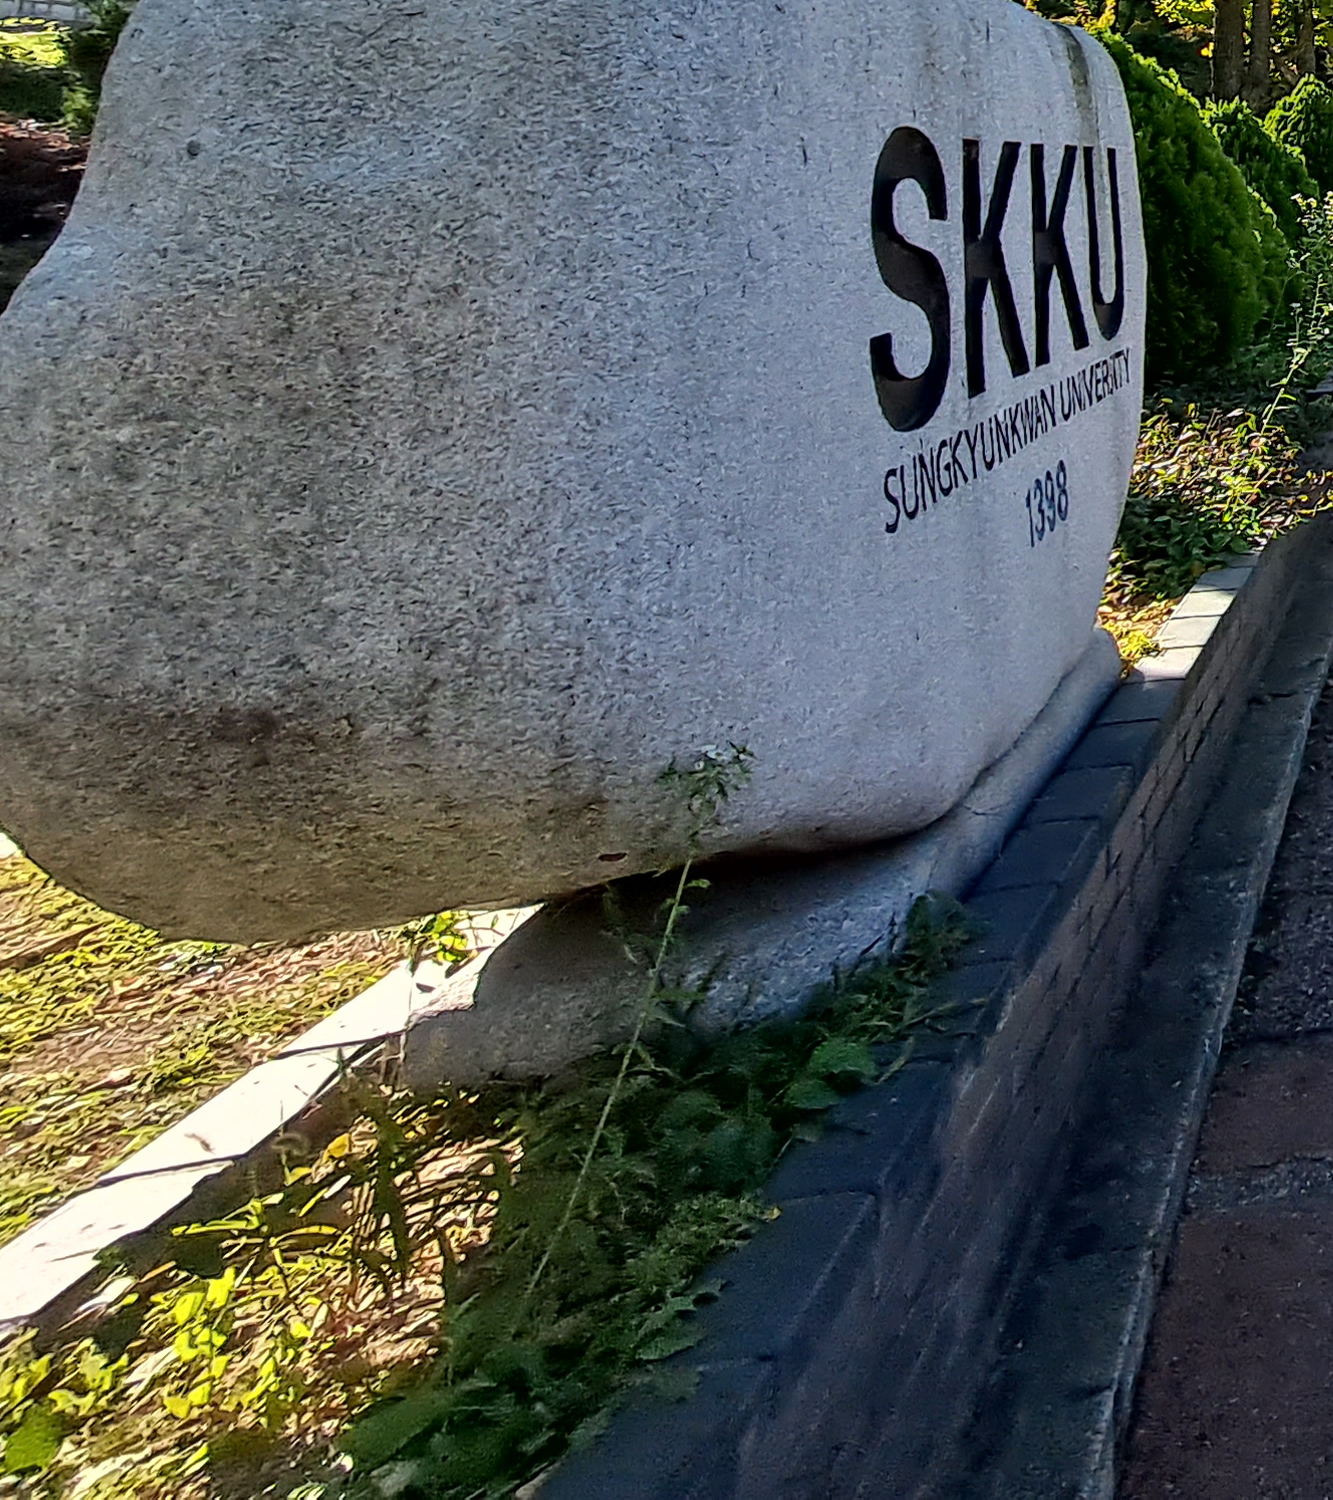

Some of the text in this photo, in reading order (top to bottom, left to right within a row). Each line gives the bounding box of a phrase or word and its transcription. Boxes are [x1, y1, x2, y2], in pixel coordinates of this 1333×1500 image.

[870, 126, 1125, 432] SKKU
[884, 347, 1130, 533] SUNGKYUNKWAN UNIVERSITY
[1026, 460, 1069, 547] 1398
